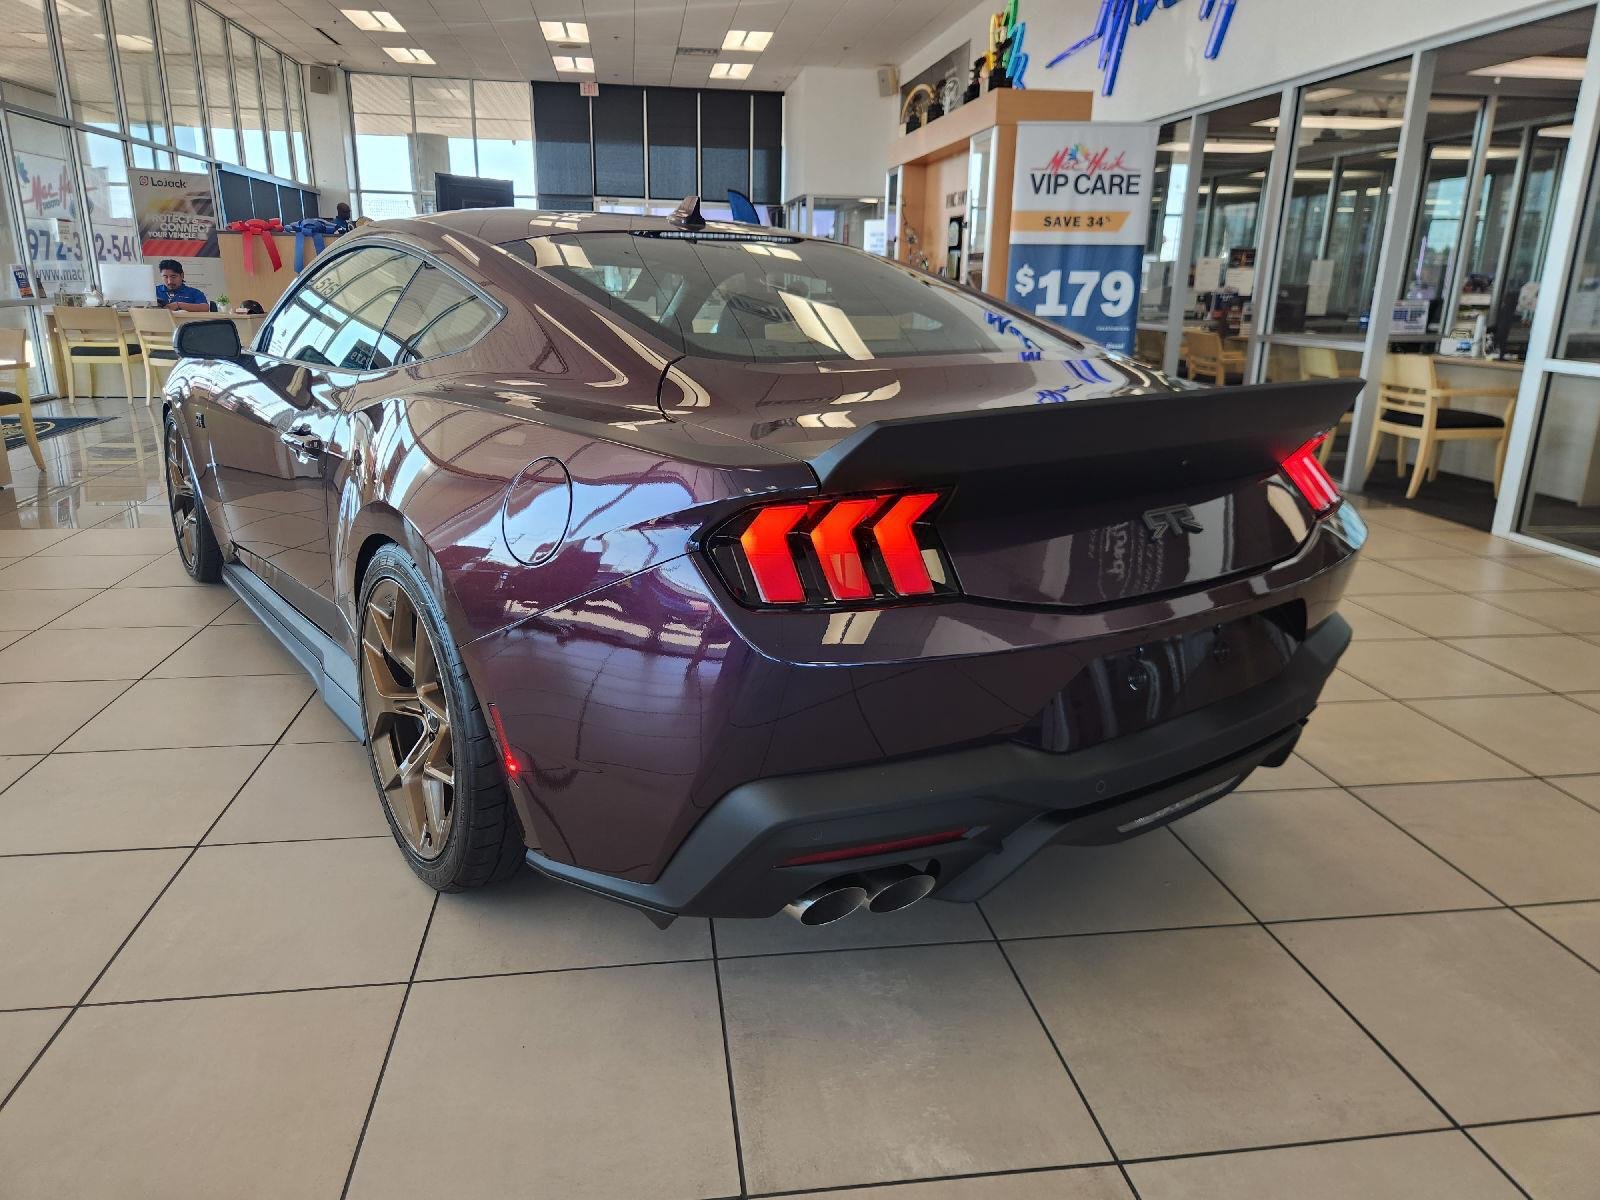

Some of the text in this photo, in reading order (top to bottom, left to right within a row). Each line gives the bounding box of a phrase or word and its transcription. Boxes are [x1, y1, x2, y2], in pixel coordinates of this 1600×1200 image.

[1030, 173, 1141, 195] VIP CARE
[1043, 216, 1081, 227] SAVE
[160, 222, 209, 233] CONNECT
[168, 231, 197, 239] VEHICLE
[1014, 263, 1135, 318] $179
